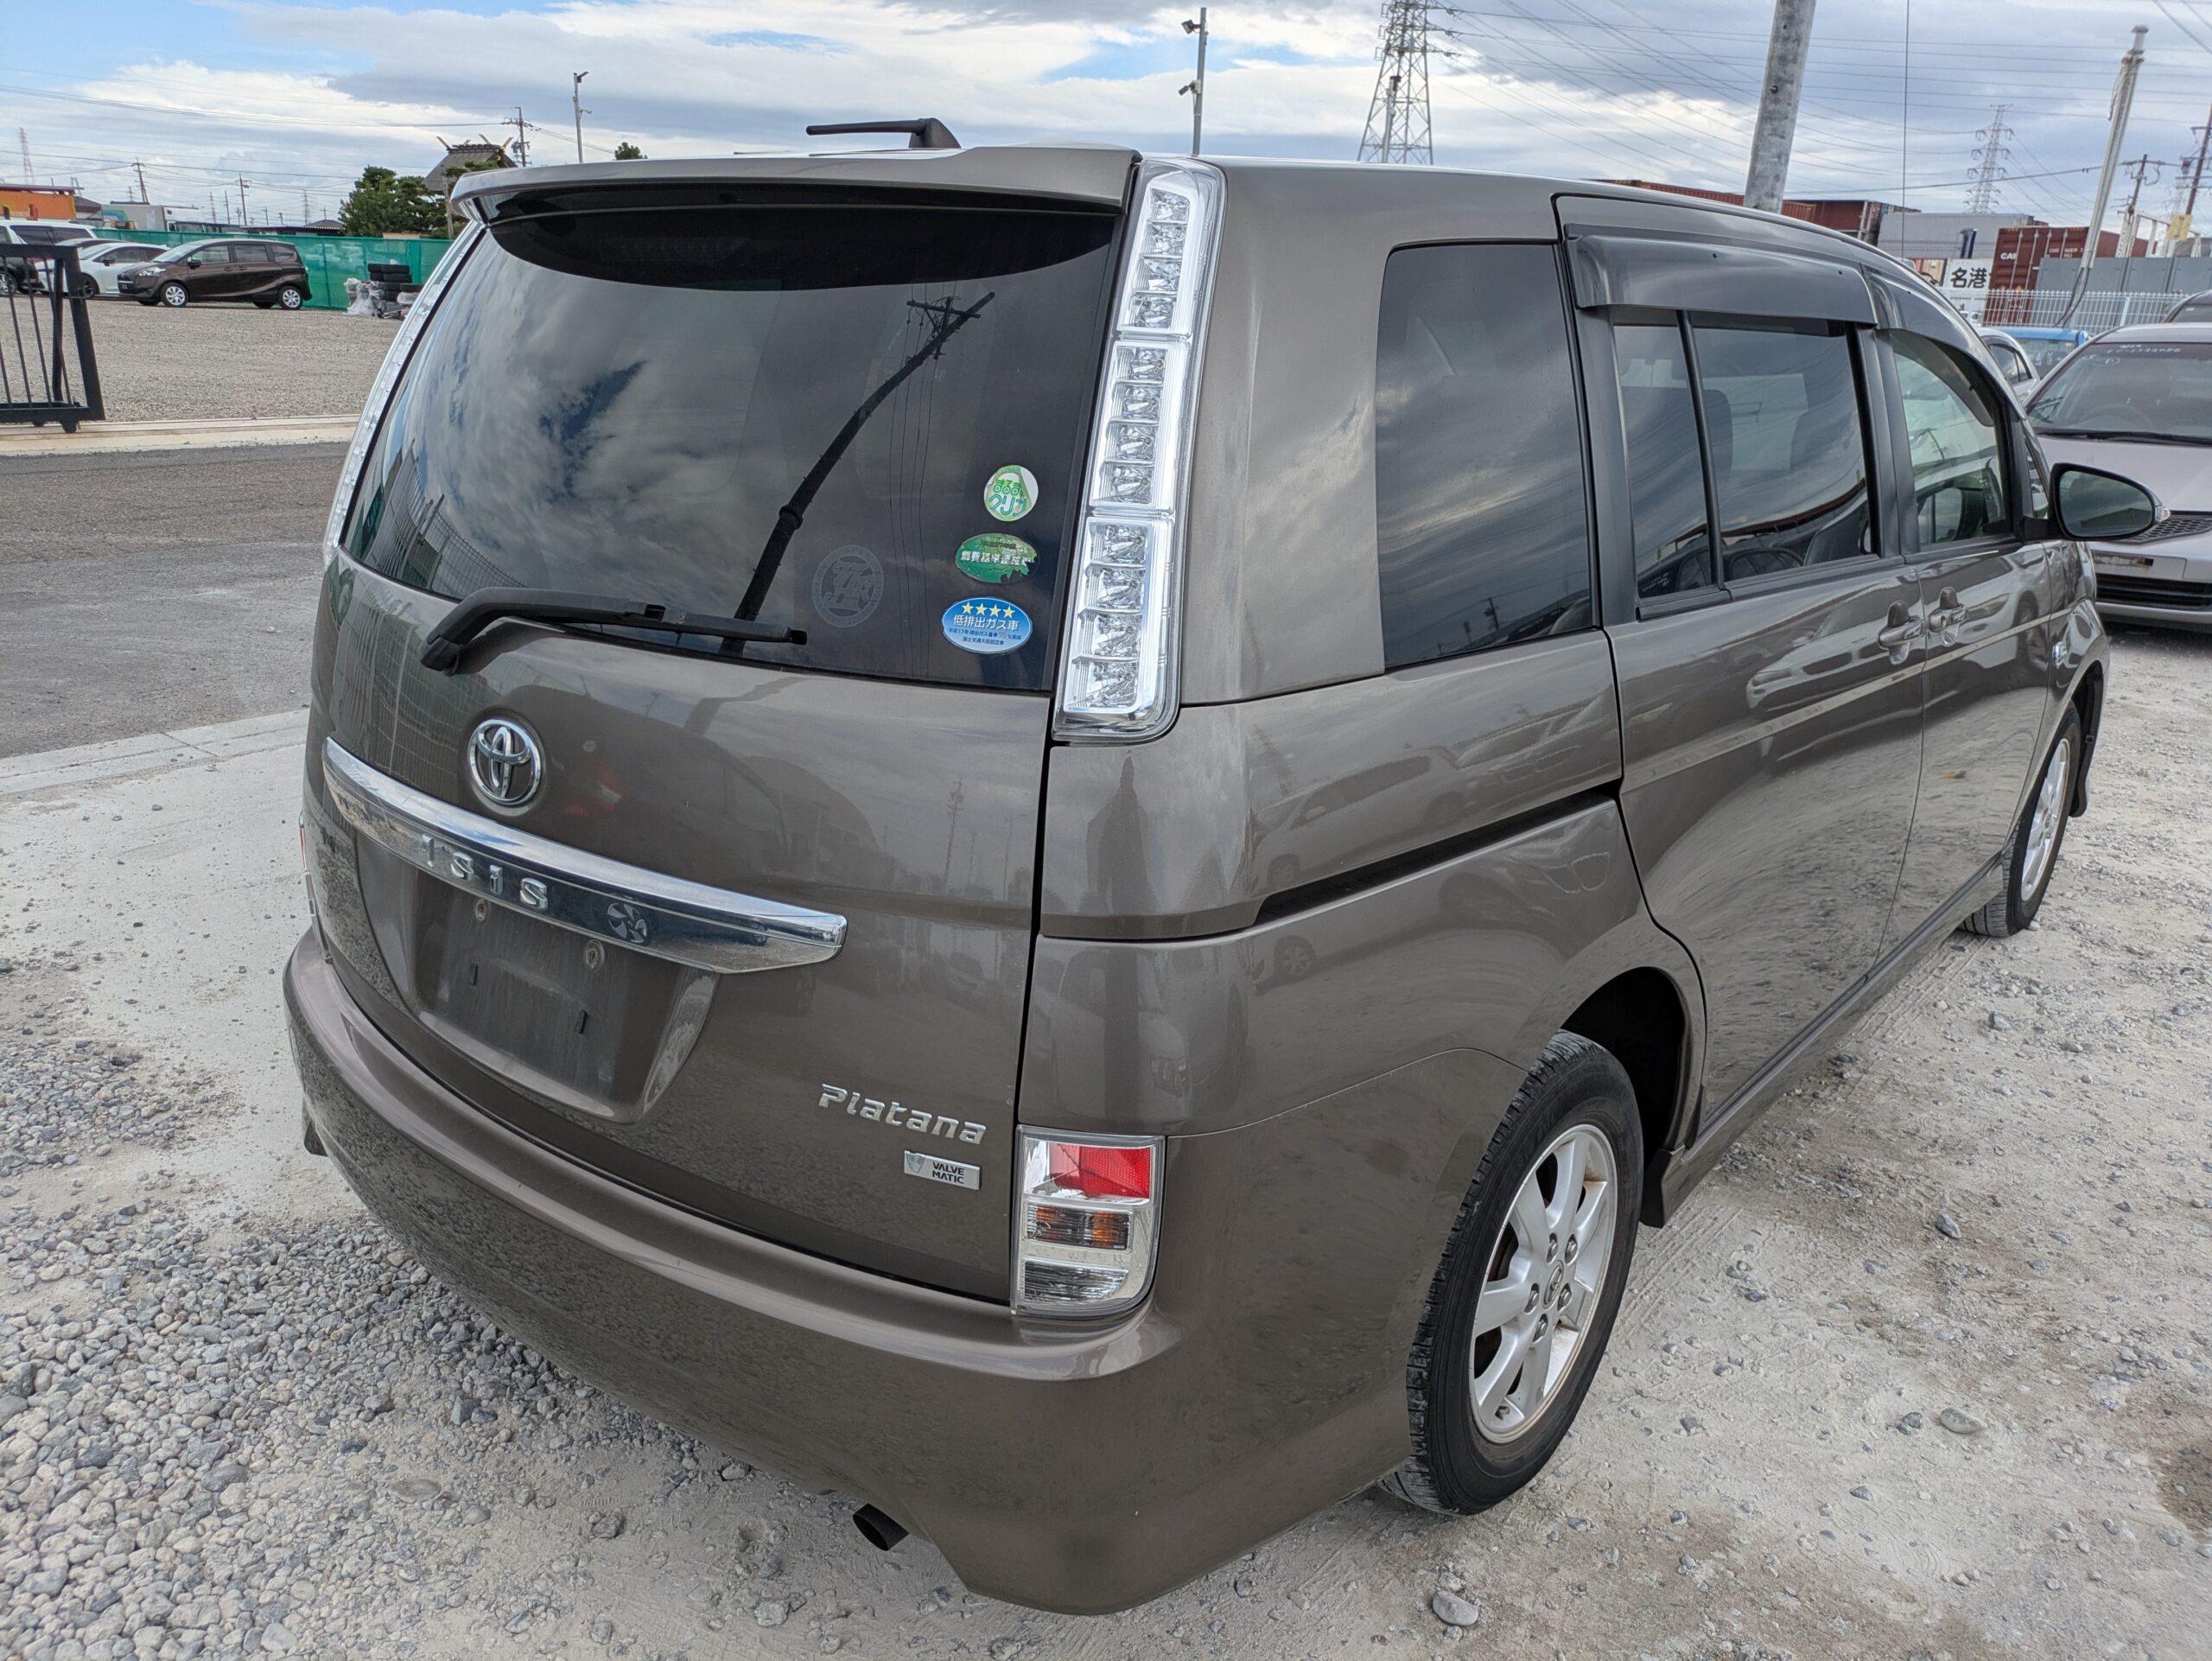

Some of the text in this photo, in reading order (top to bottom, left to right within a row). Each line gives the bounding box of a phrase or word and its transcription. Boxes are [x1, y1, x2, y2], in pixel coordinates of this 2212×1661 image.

[1950, 267, 1991, 289] 名港
[953, 614, 1020, 632] 低排出ガス車
[422, 834, 549, 911] ISIS
[818, 1083, 987, 1145] Platana
[932, 1161, 965, 1176] VALVE
[932, 1169, 965, 1185] MATIC
